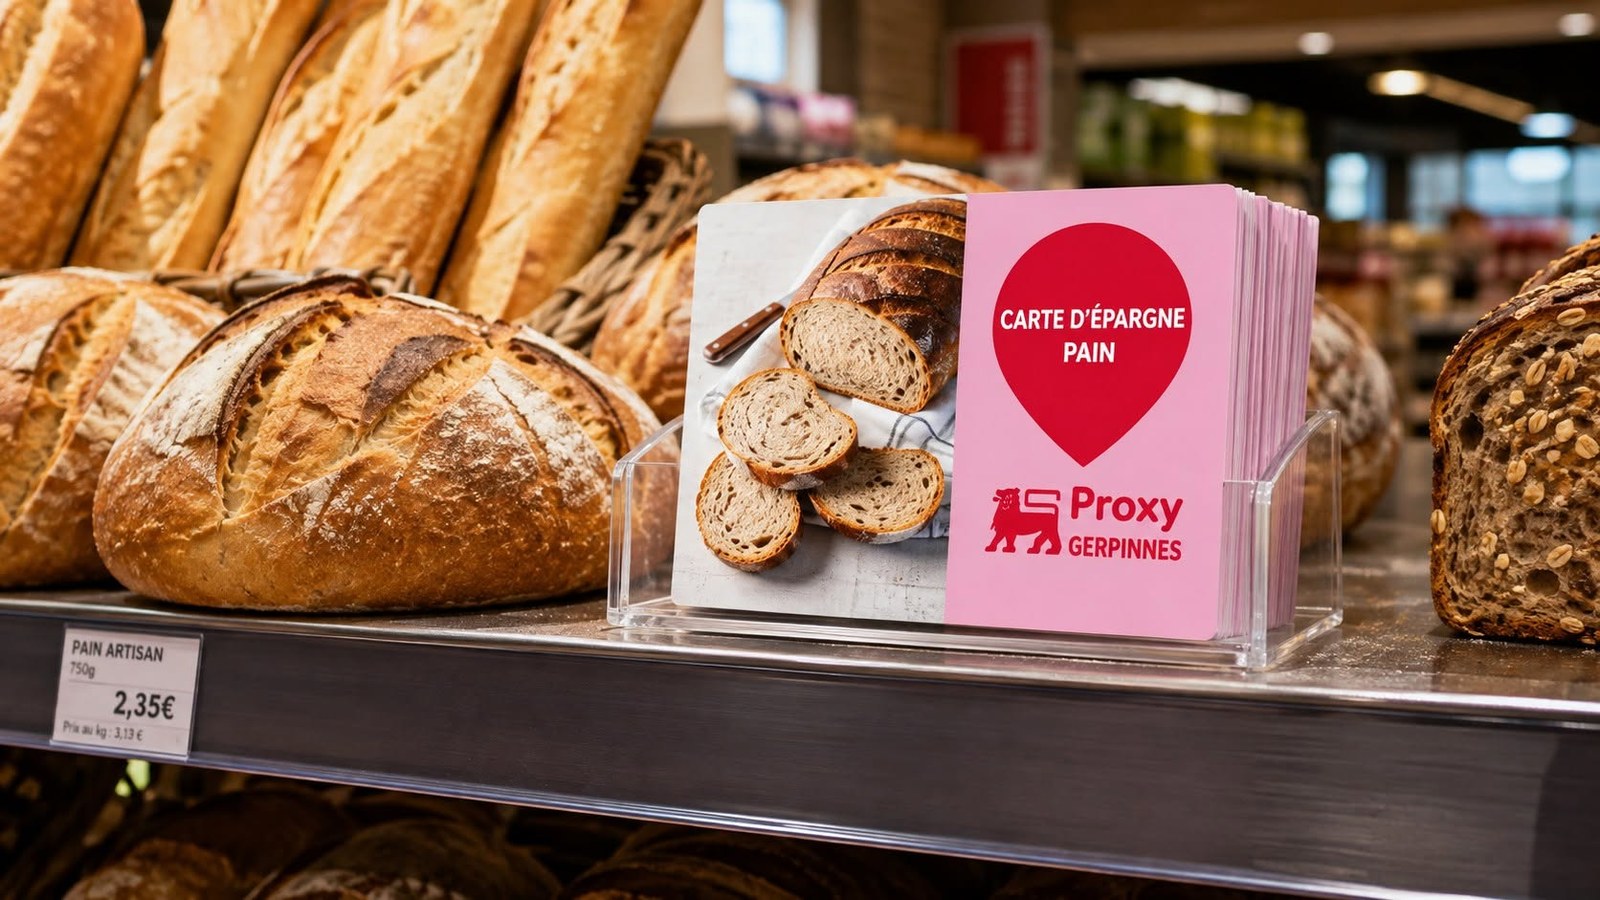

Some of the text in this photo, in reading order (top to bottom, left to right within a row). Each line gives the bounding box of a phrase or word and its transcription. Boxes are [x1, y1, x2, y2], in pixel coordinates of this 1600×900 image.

[1000, 309, 1064, 330] CARTE
[1063, 342, 1115, 363] PAIN
[1071, 486, 1183, 533] Proxy
[1068, 536, 1182, 561] GERPINNES
[72, 640, 164, 662] PAIN ARTISAN
[70, 661, 95, 679] 750g
[113, 690, 176, 720] 2,35€
[63, 720, 80, 733] Prix
[82, 726, 94, 736] au
[96, 724, 107, 739] kg
